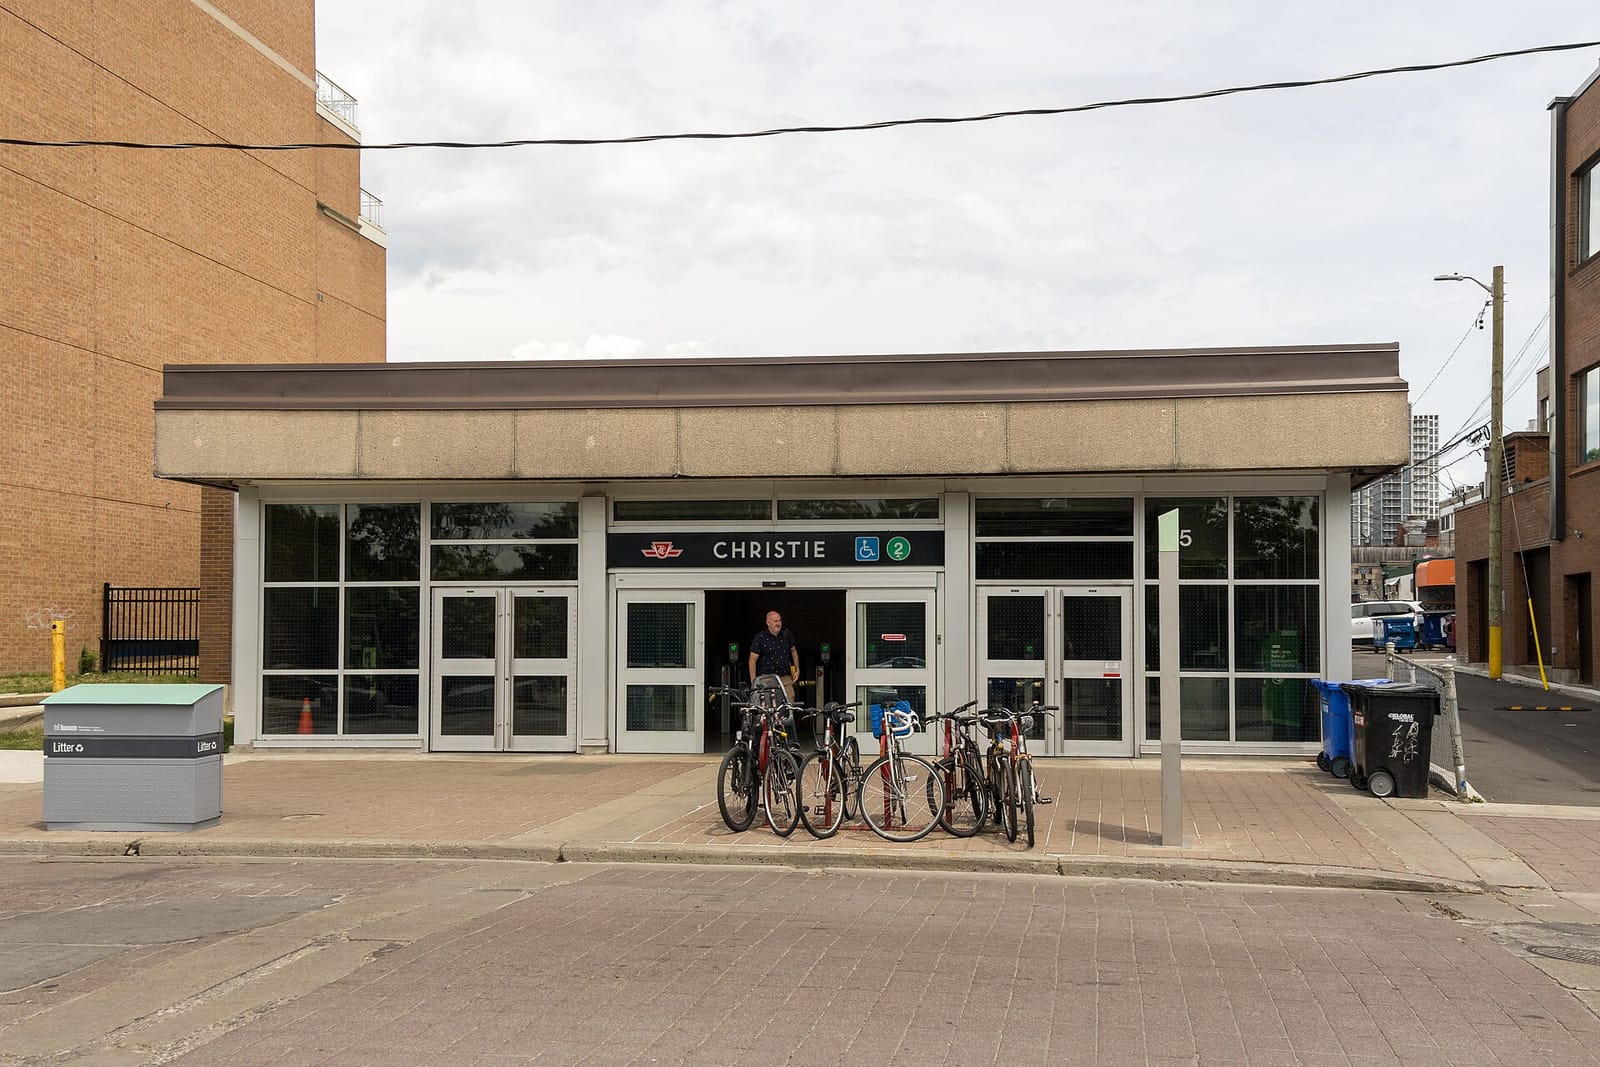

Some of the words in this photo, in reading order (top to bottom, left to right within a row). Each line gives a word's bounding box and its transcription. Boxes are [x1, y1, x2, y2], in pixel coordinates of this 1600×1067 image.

[713, 541, 825, 559] CHRISTIE
[893, 542, 904, 555] 2
[53, 742, 75, 753] Litter
[197, 741, 211, 753] Litter
